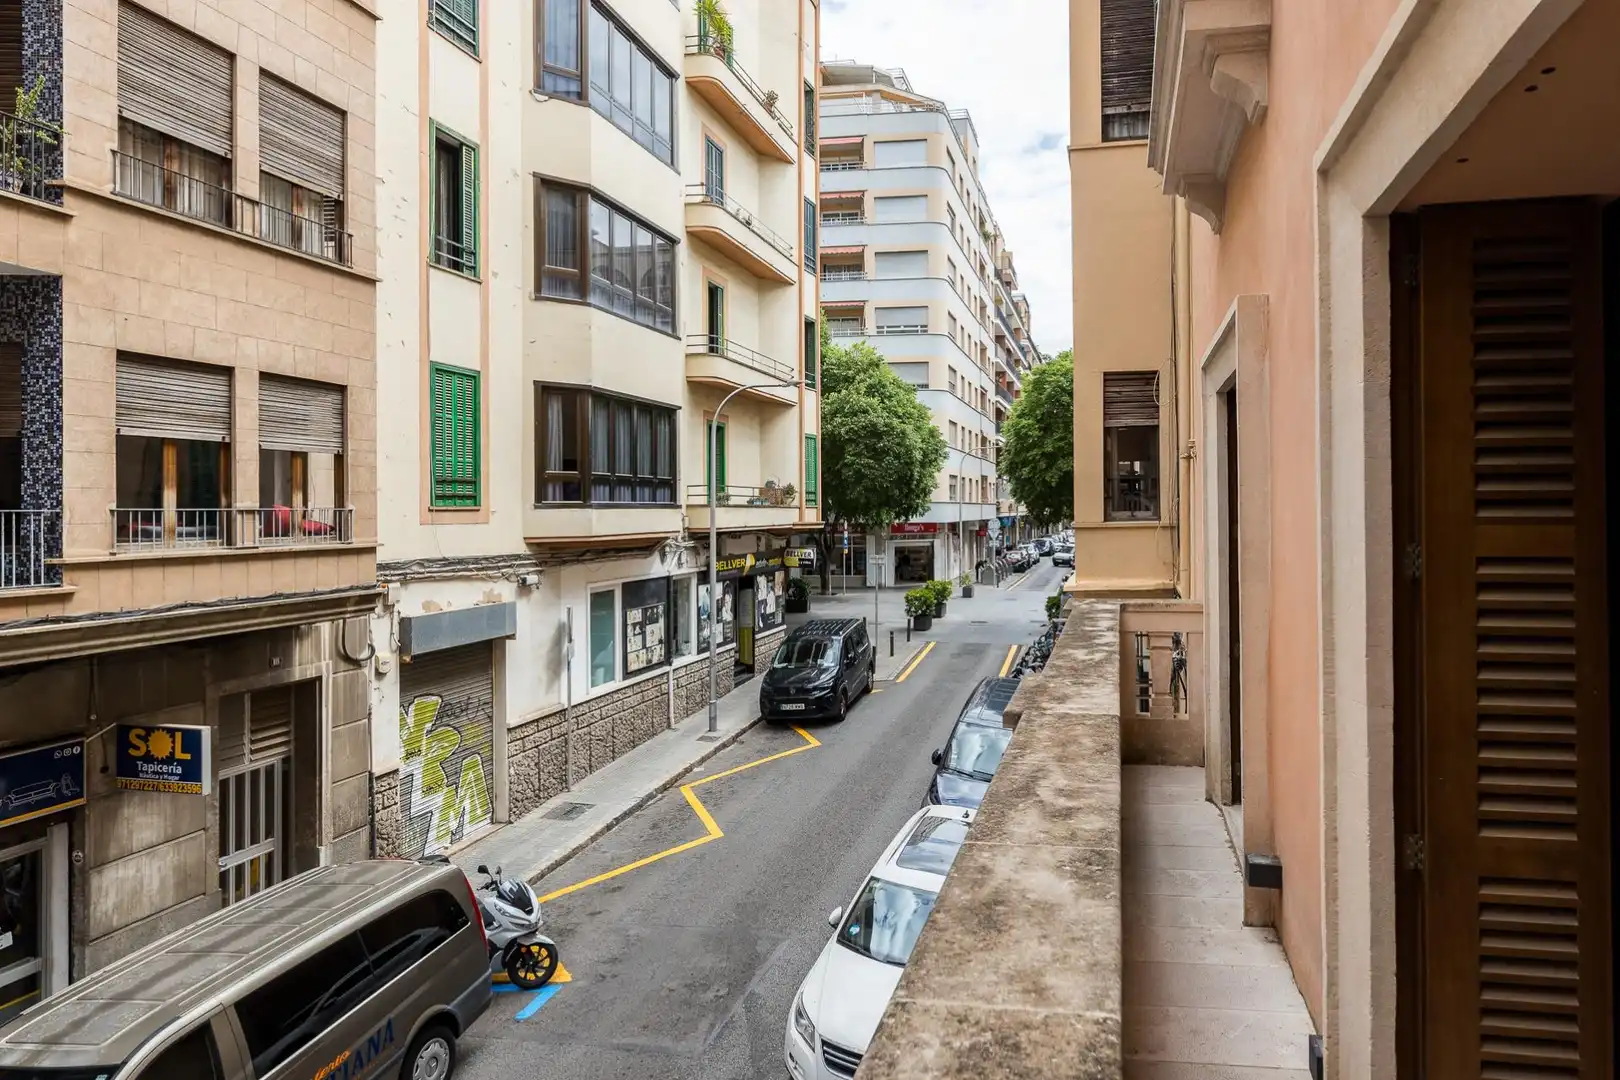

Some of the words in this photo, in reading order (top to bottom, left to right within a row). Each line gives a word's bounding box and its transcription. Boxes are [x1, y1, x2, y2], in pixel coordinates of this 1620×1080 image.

[785, 549, 812, 559] BELLVER
[128, 728, 191, 760] SOL
[136, 761, 182, 774] Tapicería
